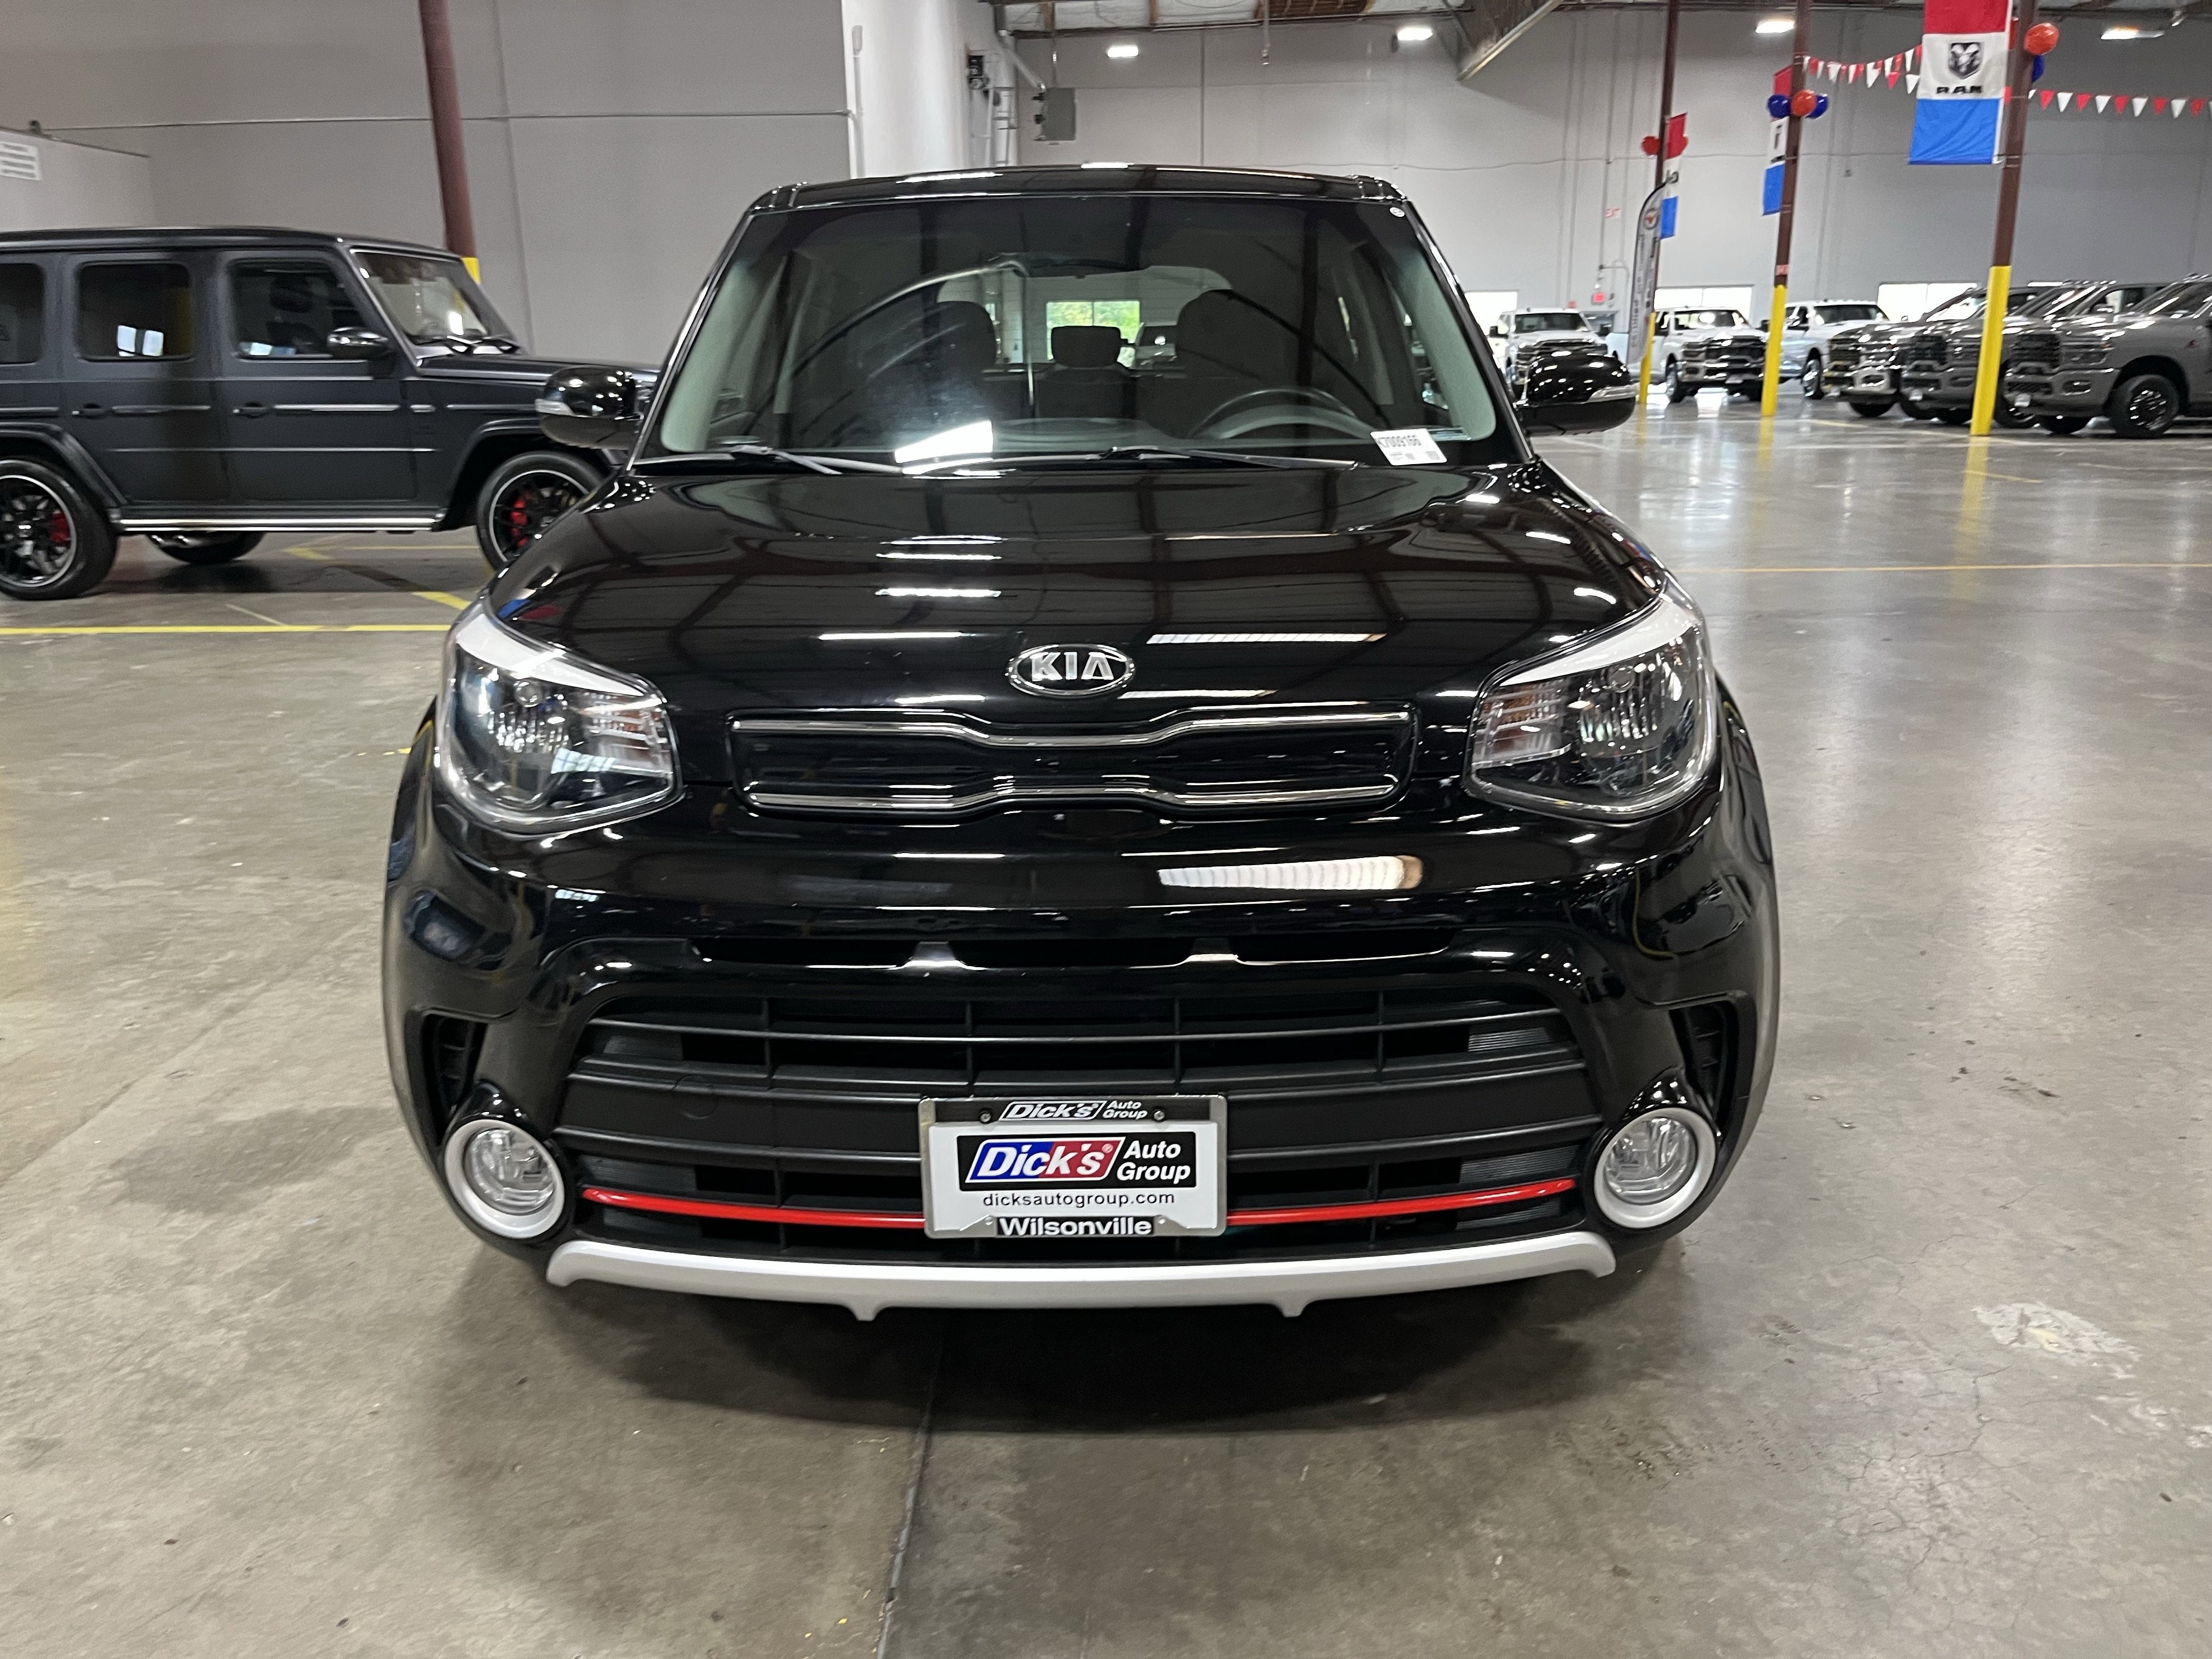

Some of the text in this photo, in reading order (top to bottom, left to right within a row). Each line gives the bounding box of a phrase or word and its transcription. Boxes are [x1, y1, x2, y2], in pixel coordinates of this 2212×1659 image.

[1937, 86, 1982, 94] RAM
[1030, 652, 1114, 681] KIA
[1106, 1100, 1142, 1109] Auto
[1102, 1109, 1148, 1120] Group
[1122, 1140, 1181, 1160] Auto
[1116, 1161, 1191, 1184] Group
[983, 1192, 1175, 1208] dicksautogroup.com
[998, 1216, 1152, 1236] Wilsonville
